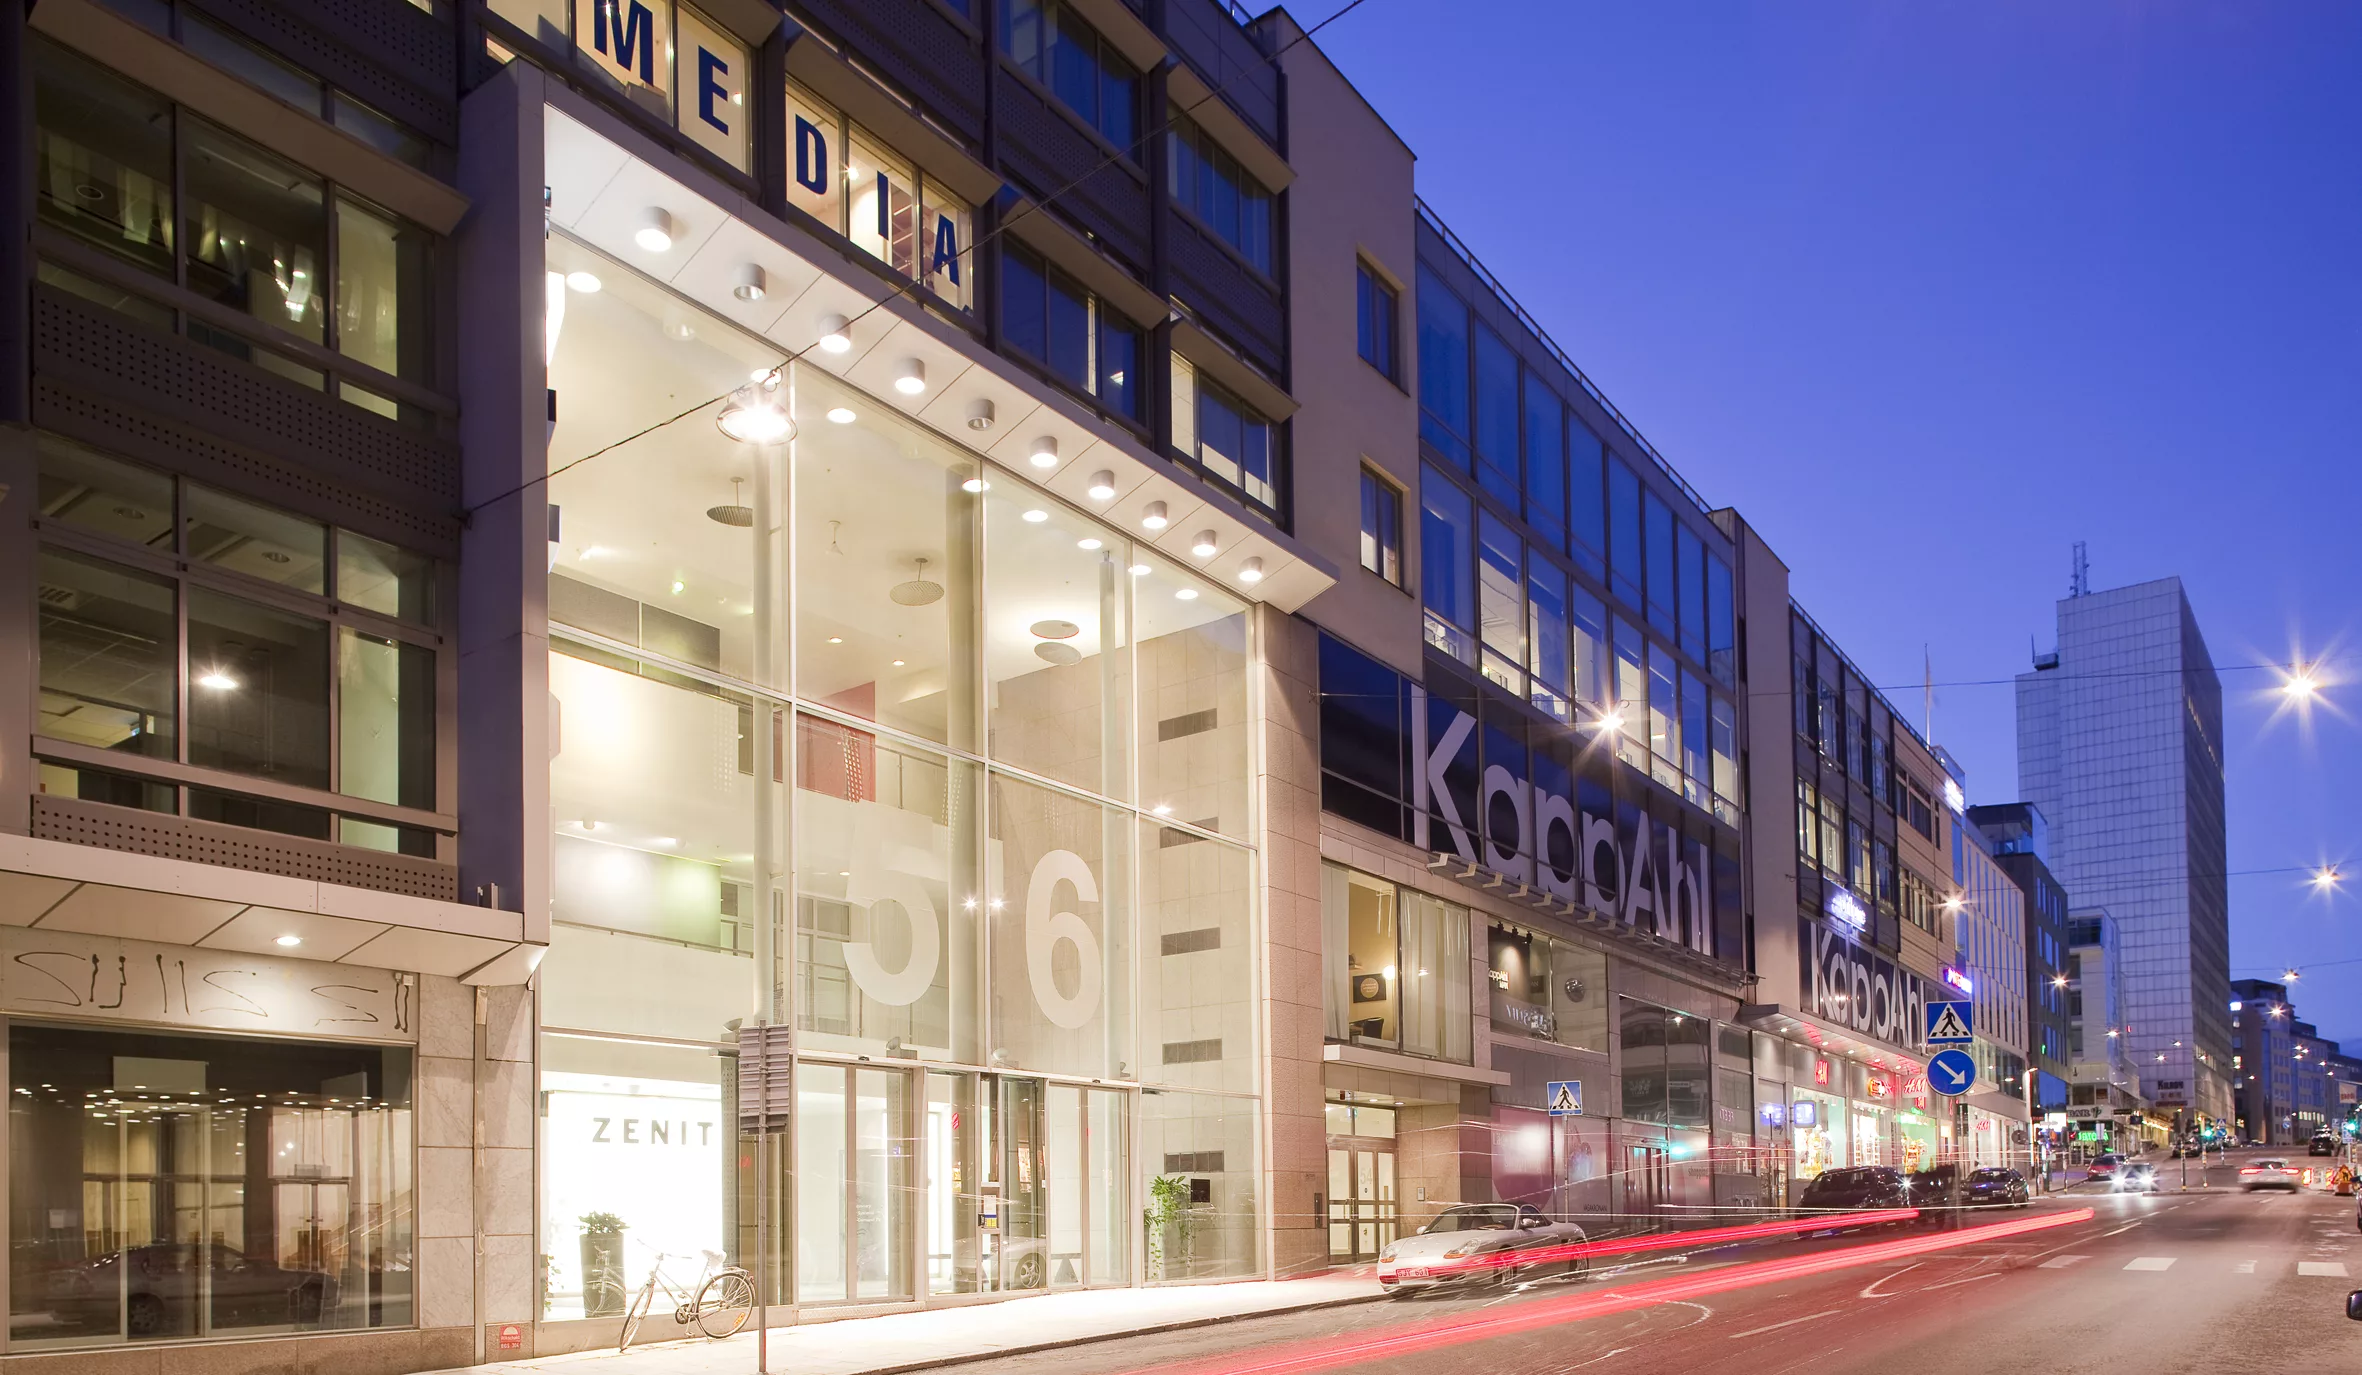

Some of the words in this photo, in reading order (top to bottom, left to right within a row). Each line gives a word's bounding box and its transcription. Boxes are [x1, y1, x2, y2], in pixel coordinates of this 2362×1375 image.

[594, 0, 960, 286] MEDIA
[1411, 683, 1711, 956] KappAhl
[1810, 921, 1926, 1053] KappAhl
[592, 1117, 713, 1146] ZENIT
[1360, 1167, 1373, 1185] 54
